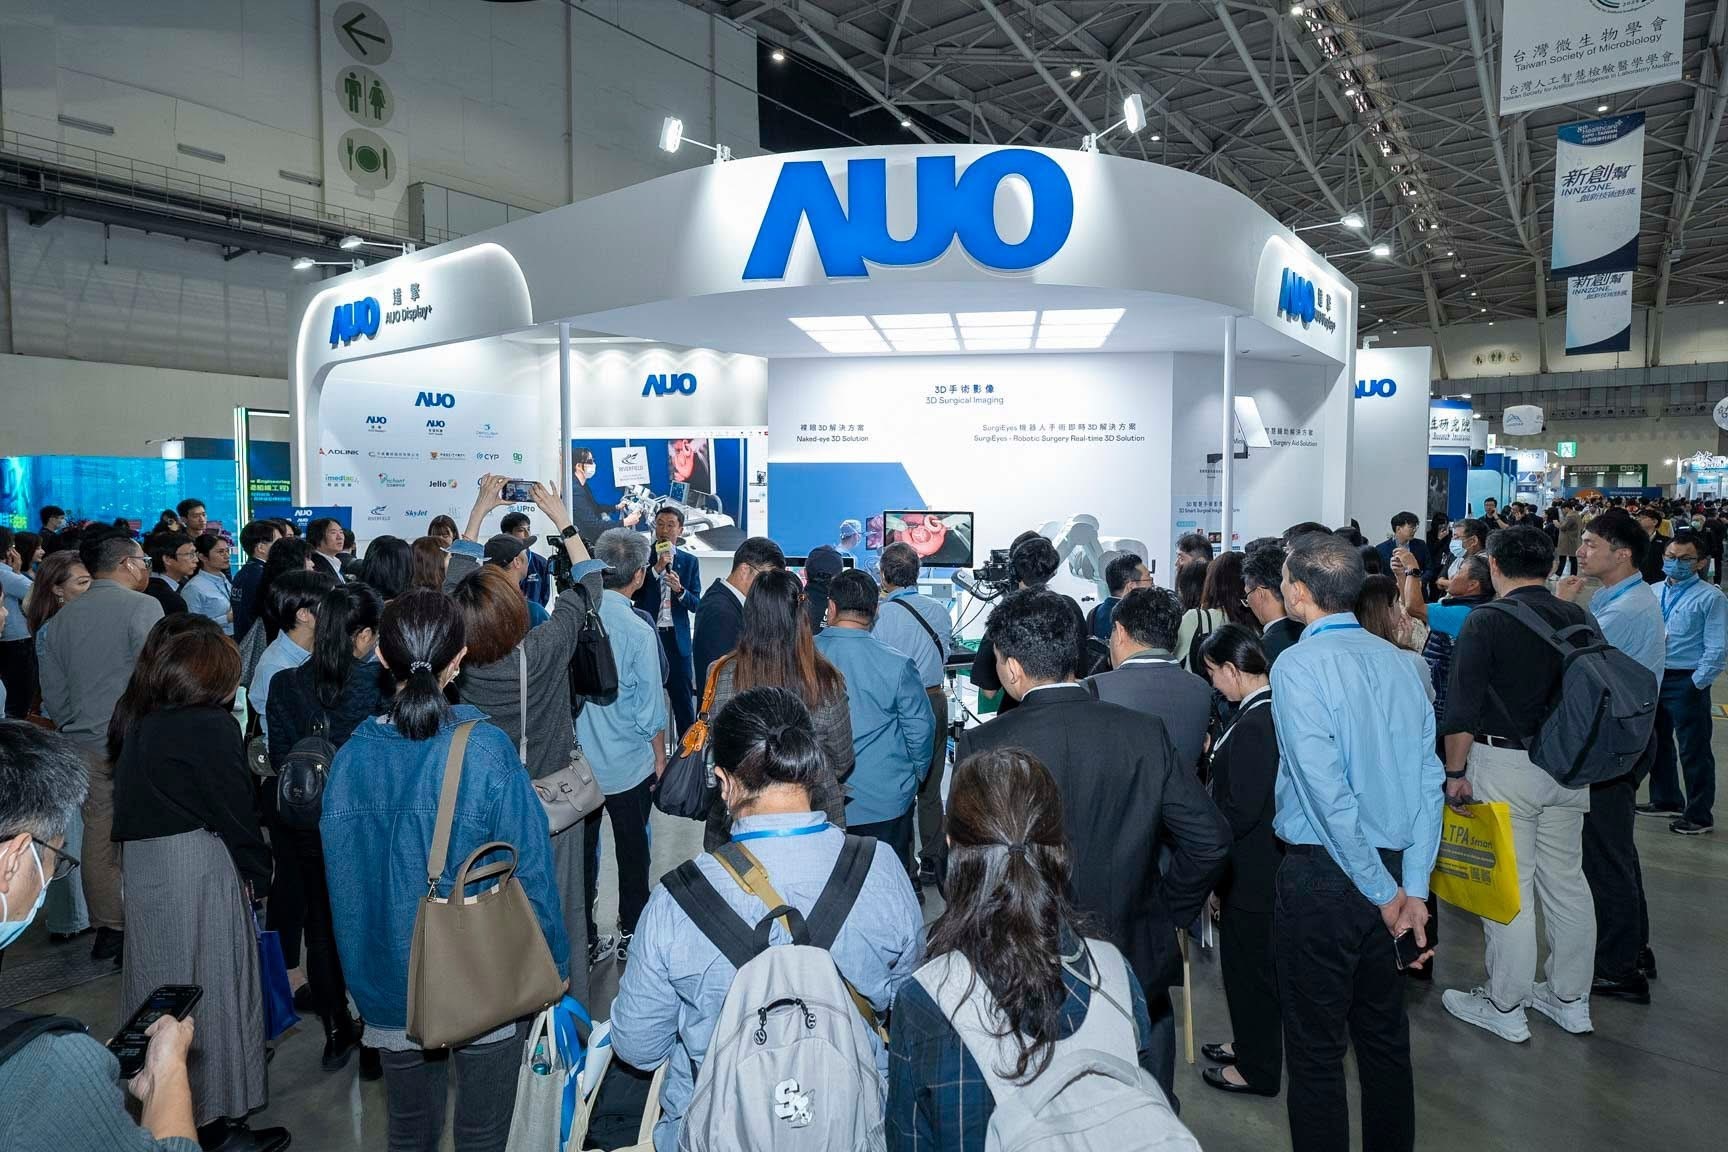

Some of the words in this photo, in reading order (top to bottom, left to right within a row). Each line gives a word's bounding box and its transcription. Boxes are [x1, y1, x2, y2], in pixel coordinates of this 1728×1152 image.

[1513, 15, 1667, 63] 台灣微生物學會
[1515, 59, 1547, 72] Taiwan
[1549, 49, 1584, 64] Society
[1587, 46, 1596, 56] of
[1599, 34, 1662, 53] Microbiology
[1509, 50, 1674, 95] 台灣人工智慧檢驗醫學學會
[1523, 89, 1543, 98] Society
[1617, 65, 1651, 77] Laboratory
[1651, 60, 1680, 70] Medicine
[1561, 183, 1614, 196] INNZONE
[742, 149, 1073, 280] AUO
[1279, 267, 1315, 323] AUO
[1572, 286, 1611, 295] INNZONE
[329, 296, 380, 345] AUO
[386, 309, 400, 324] AUO
[642, 373, 697, 396] AUO
[934, 384, 994, 394] 3D手術影像
[415, 392, 455, 408] AUO
[939, 396, 971, 405] Surgical
[973, 396, 1004, 405] Imaging
[366, 416, 386, 424] AUO
[797, 435, 830, 443] Naked-eye
[1013, 434, 1040, 442] Robotic
[1041, 434, 1069, 443] Surgery
[1070, 434, 1103, 442] Real-time
[1104, 434, 1114, 442] 3D
[1116, 434, 1145, 442] Solution
[1272, 440, 1291, 448] Surgery
[429, 480, 447, 488] Jello
[294, 509, 312, 517] AUO
[404, 509, 428, 517] SkyJet
[516, 505, 536, 513] UPro
